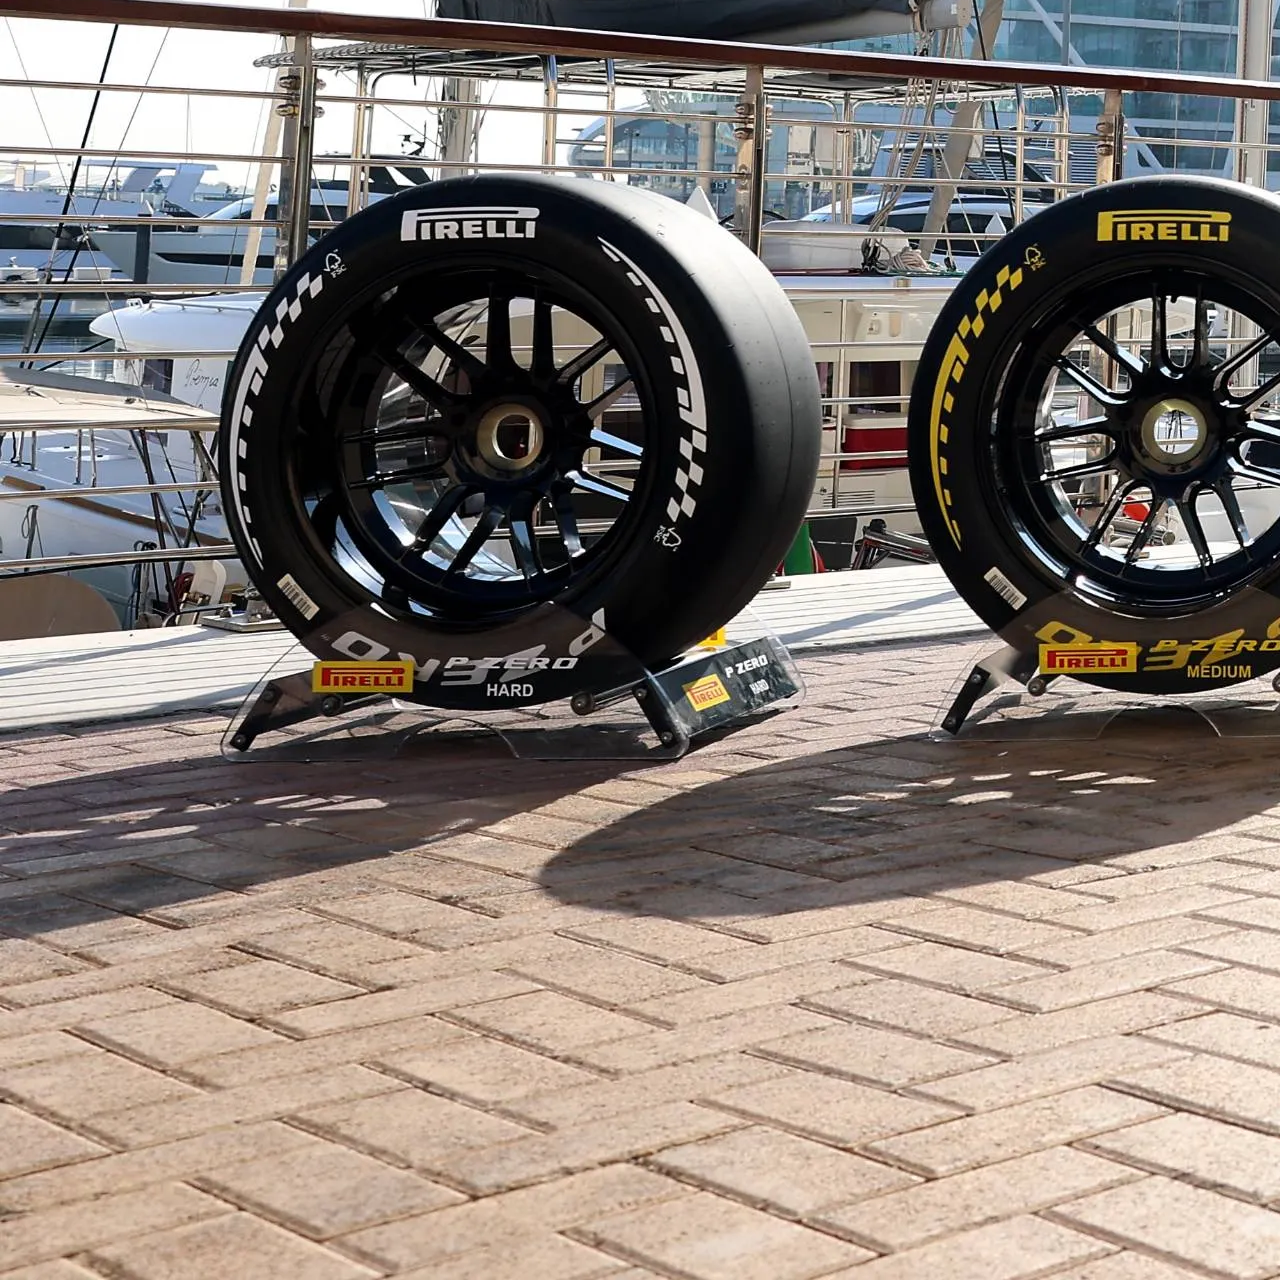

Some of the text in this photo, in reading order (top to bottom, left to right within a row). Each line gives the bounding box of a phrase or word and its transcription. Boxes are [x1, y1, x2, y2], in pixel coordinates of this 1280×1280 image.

[400, 207, 540, 241] PIRELLI
[1097, 209, 1232, 242] PIRELLI
[484, 657, 579, 669] ZERO
[737, 654, 769, 675] ZERO
[1047, 649, 1128, 669] PIRELLI
[321, 667, 405, 687] PIRELLI
[1187, 665, 1252, 678] MEDIUM
[486, 683, 534, 697] HARD
[687, 680, 723, 705] PIRELLI
[750, 679, 769, 695] HARD
